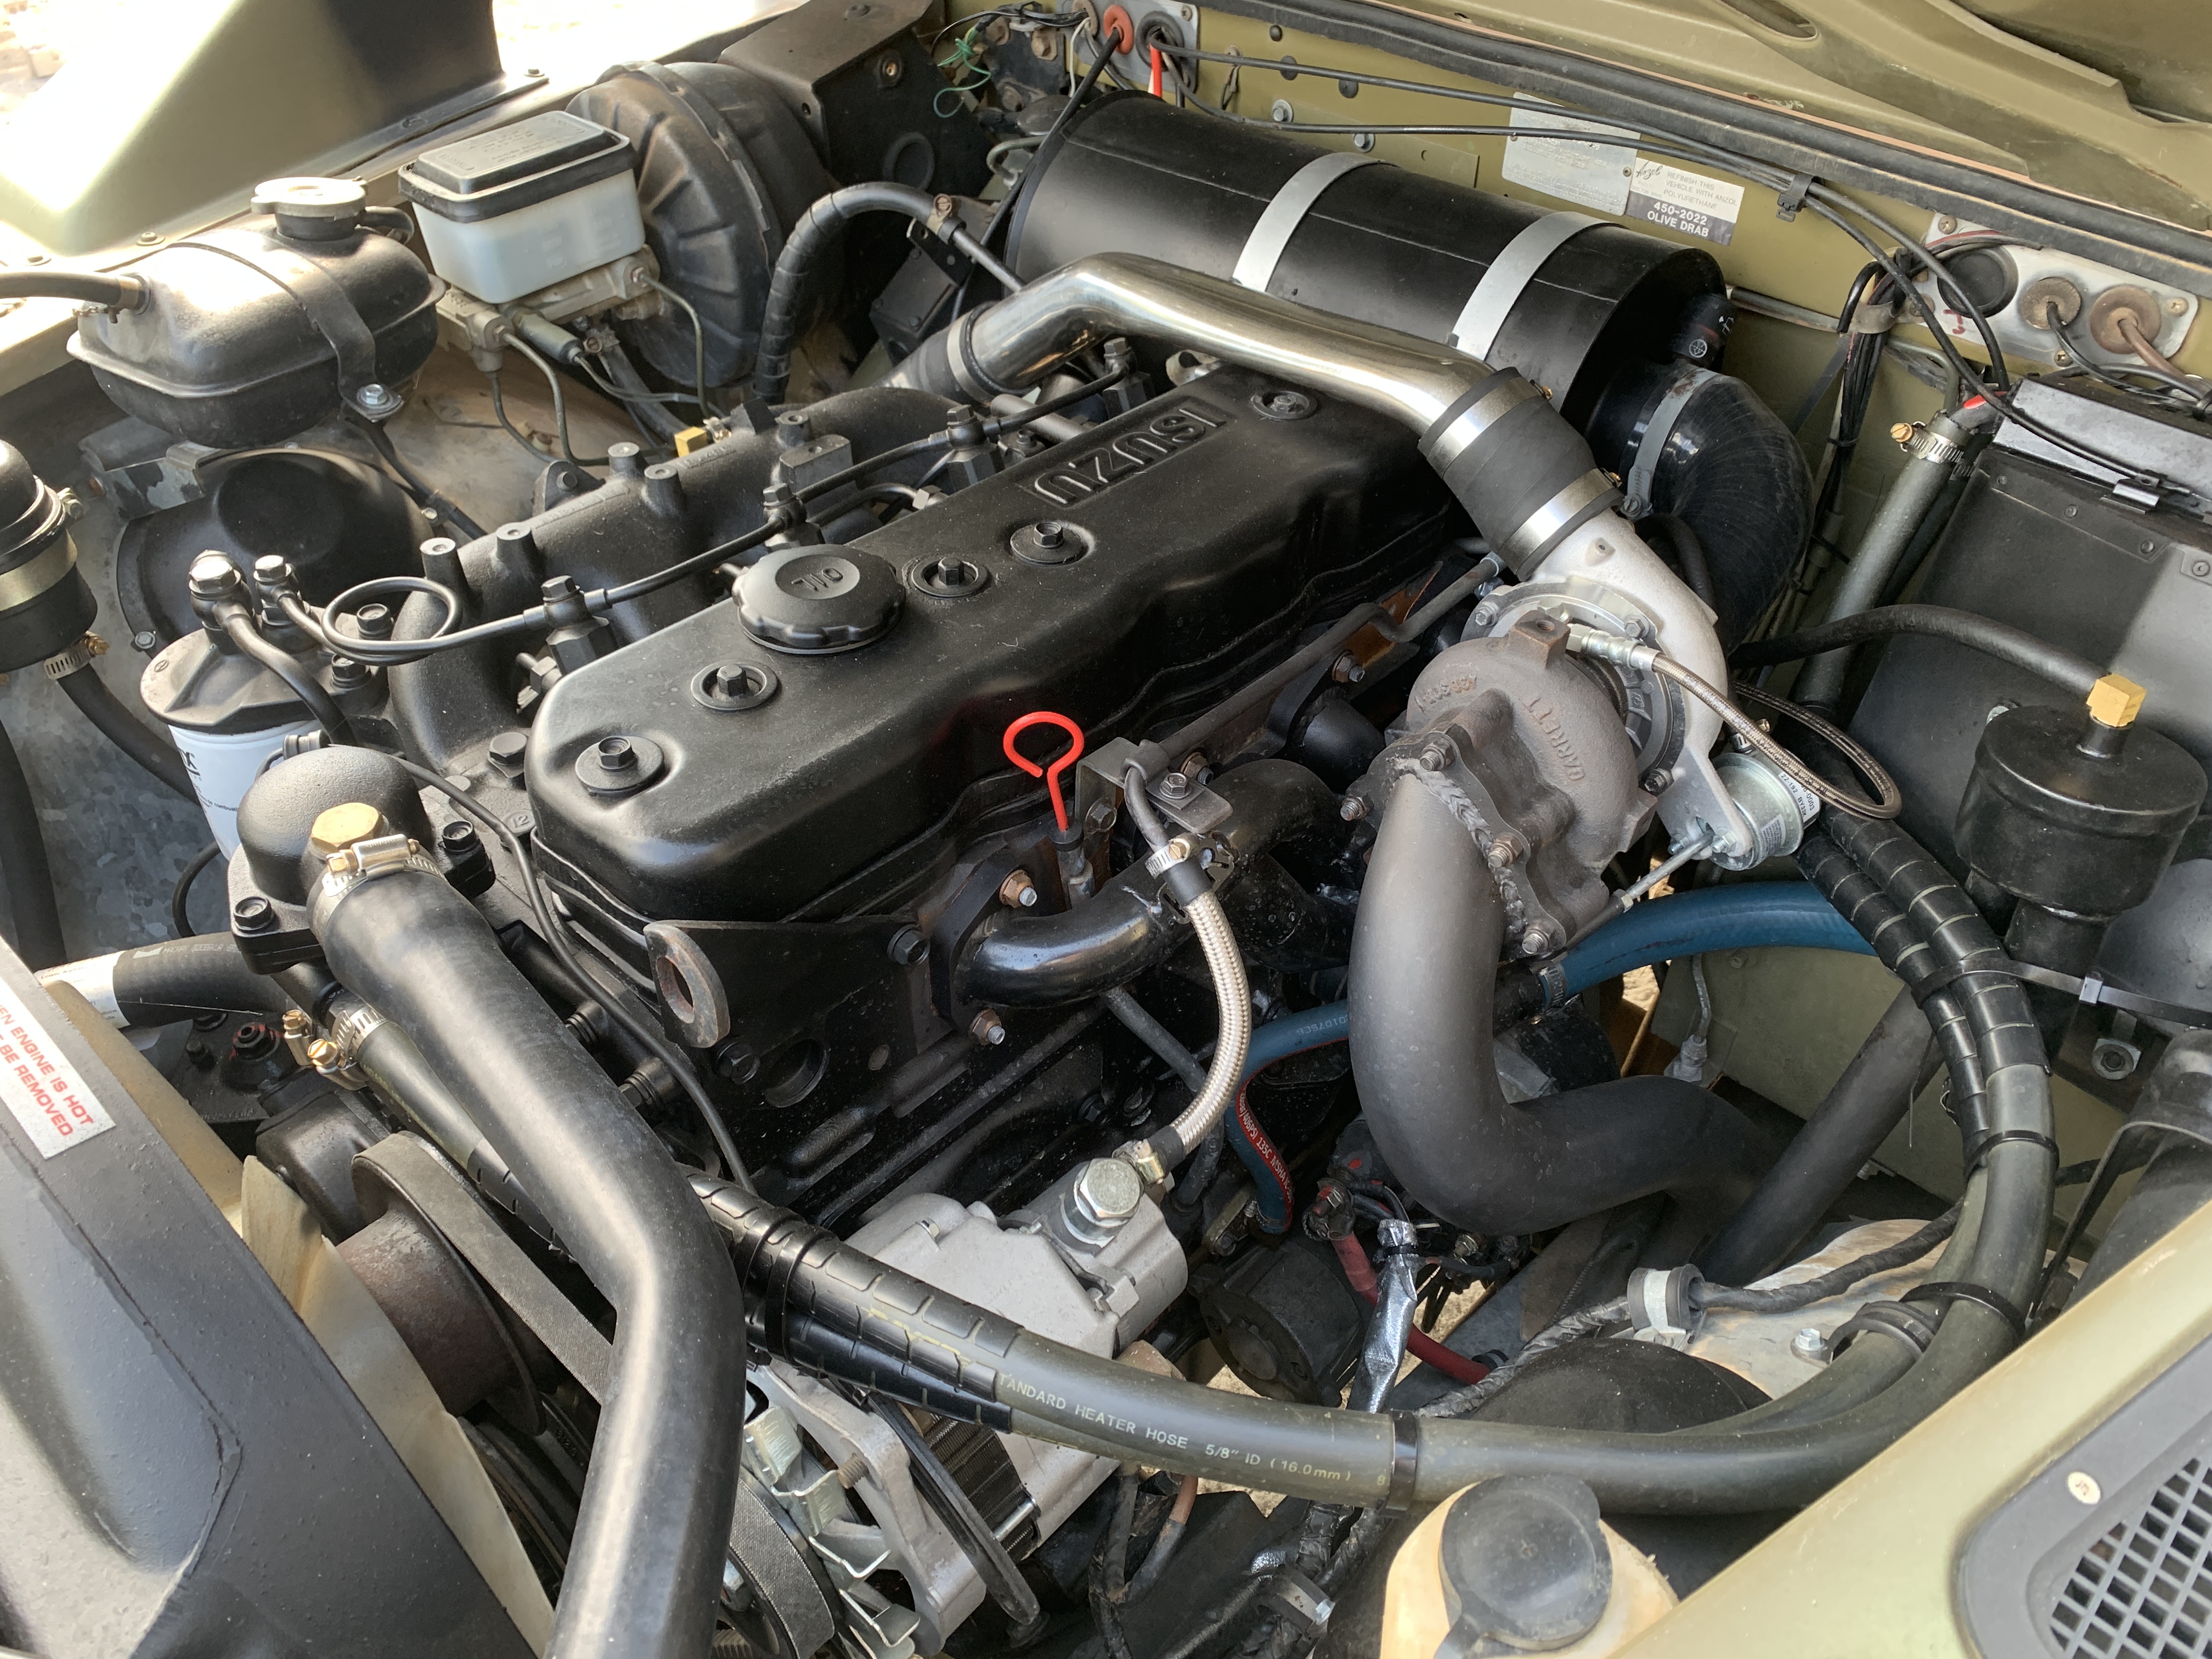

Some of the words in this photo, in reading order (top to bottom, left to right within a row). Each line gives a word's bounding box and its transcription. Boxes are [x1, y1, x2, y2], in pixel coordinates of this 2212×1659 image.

[1666, 179, 1694, 196] VEHICLE
[1695, 188, 1713, 200] WITH
[1714, 194, 1737, 206] ANZOL
[1667, 171, 1698, 188] REFINISH
[1699, 179, 1716, 190] THIS
[1653, 201, 1708, 226] 450-2022
[1663, 189, 1718, 211] POLYURETHANE
[1647, 211, 1677, 228] OLIVE
[1680, 221, 1709, 238] DRAB
[1034, 407, 1227, 505] ISUZU
[790, 568, 844, 591] OIL
[1781, 774, 1798, 793] 22-192
[1801, 785, 1815, 811] -0003
[10, 1026, 56, 1076] ENGINE
[50, 1076, 69, 1093] IS
[63, 1094, 94, 1126] HOT
[0, 1043, 20, 1064] BE
[14, 1063, 74, 1137] REMOVED
[1255, 1137, 1273, 1159] 135C
[1269, 1156, 1287, 1181] MSHA
[998, 1373, 1066, 1410] TANDARD
[1075, 1403, 1136, 1435] HEATER
[1146, 1427, 1188, 1449] HOSE
[1205, 1443, 1240, 1460] 5/8"
[1245, 1452, 1261, 1466] ID
